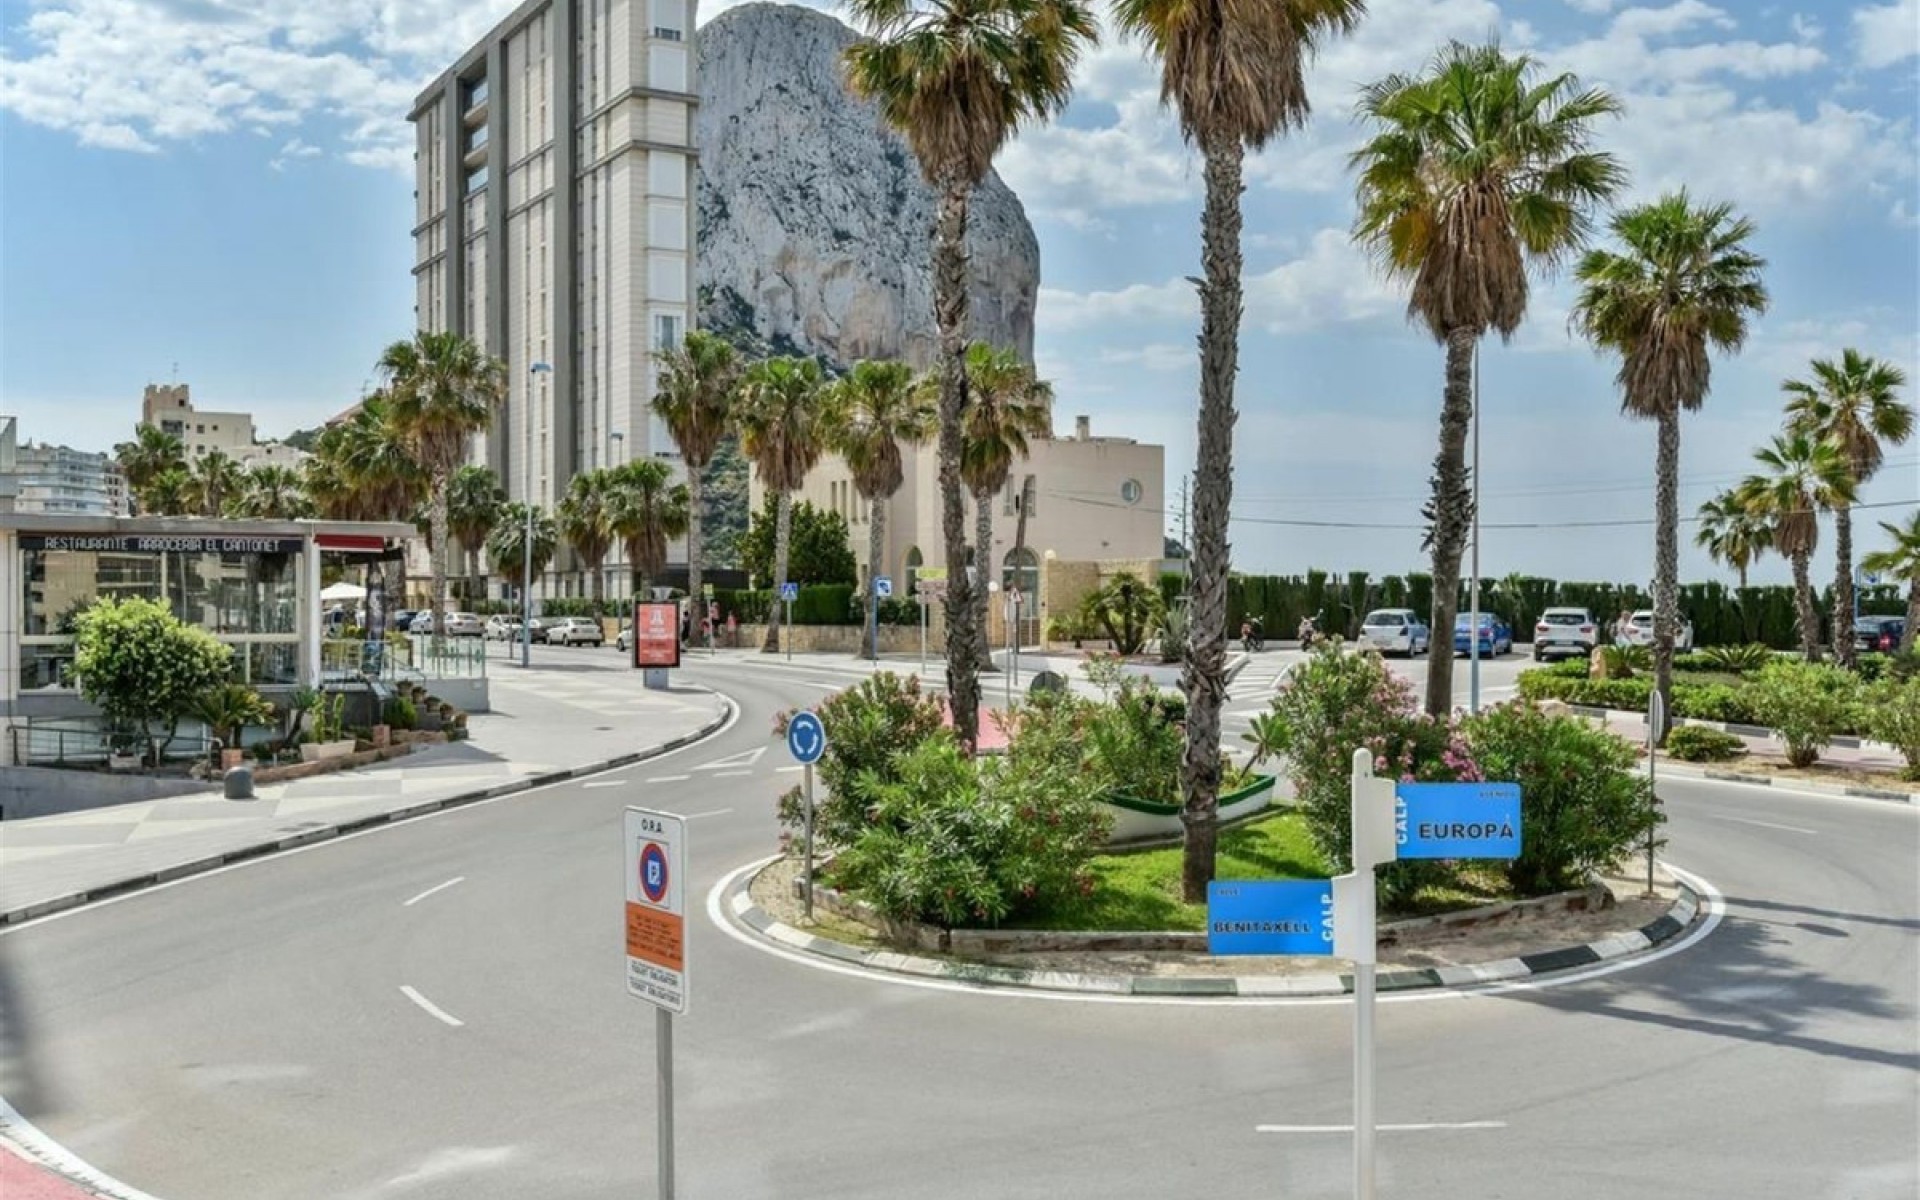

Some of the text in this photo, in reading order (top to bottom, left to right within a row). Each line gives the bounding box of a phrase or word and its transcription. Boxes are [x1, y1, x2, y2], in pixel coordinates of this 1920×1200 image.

[44, 537, 129, 550] RESTAURANTE
[206, 539, 221, 552] EL
[223, 539, 280, 552] CANTONET
[1396, 795, 1409, 845] CALP
[1419, 823, 1514, 839] EUROPA
[1321, 893, 1333, 942] CALP
[1213, 920, 1311, 934] BENITAXELL
